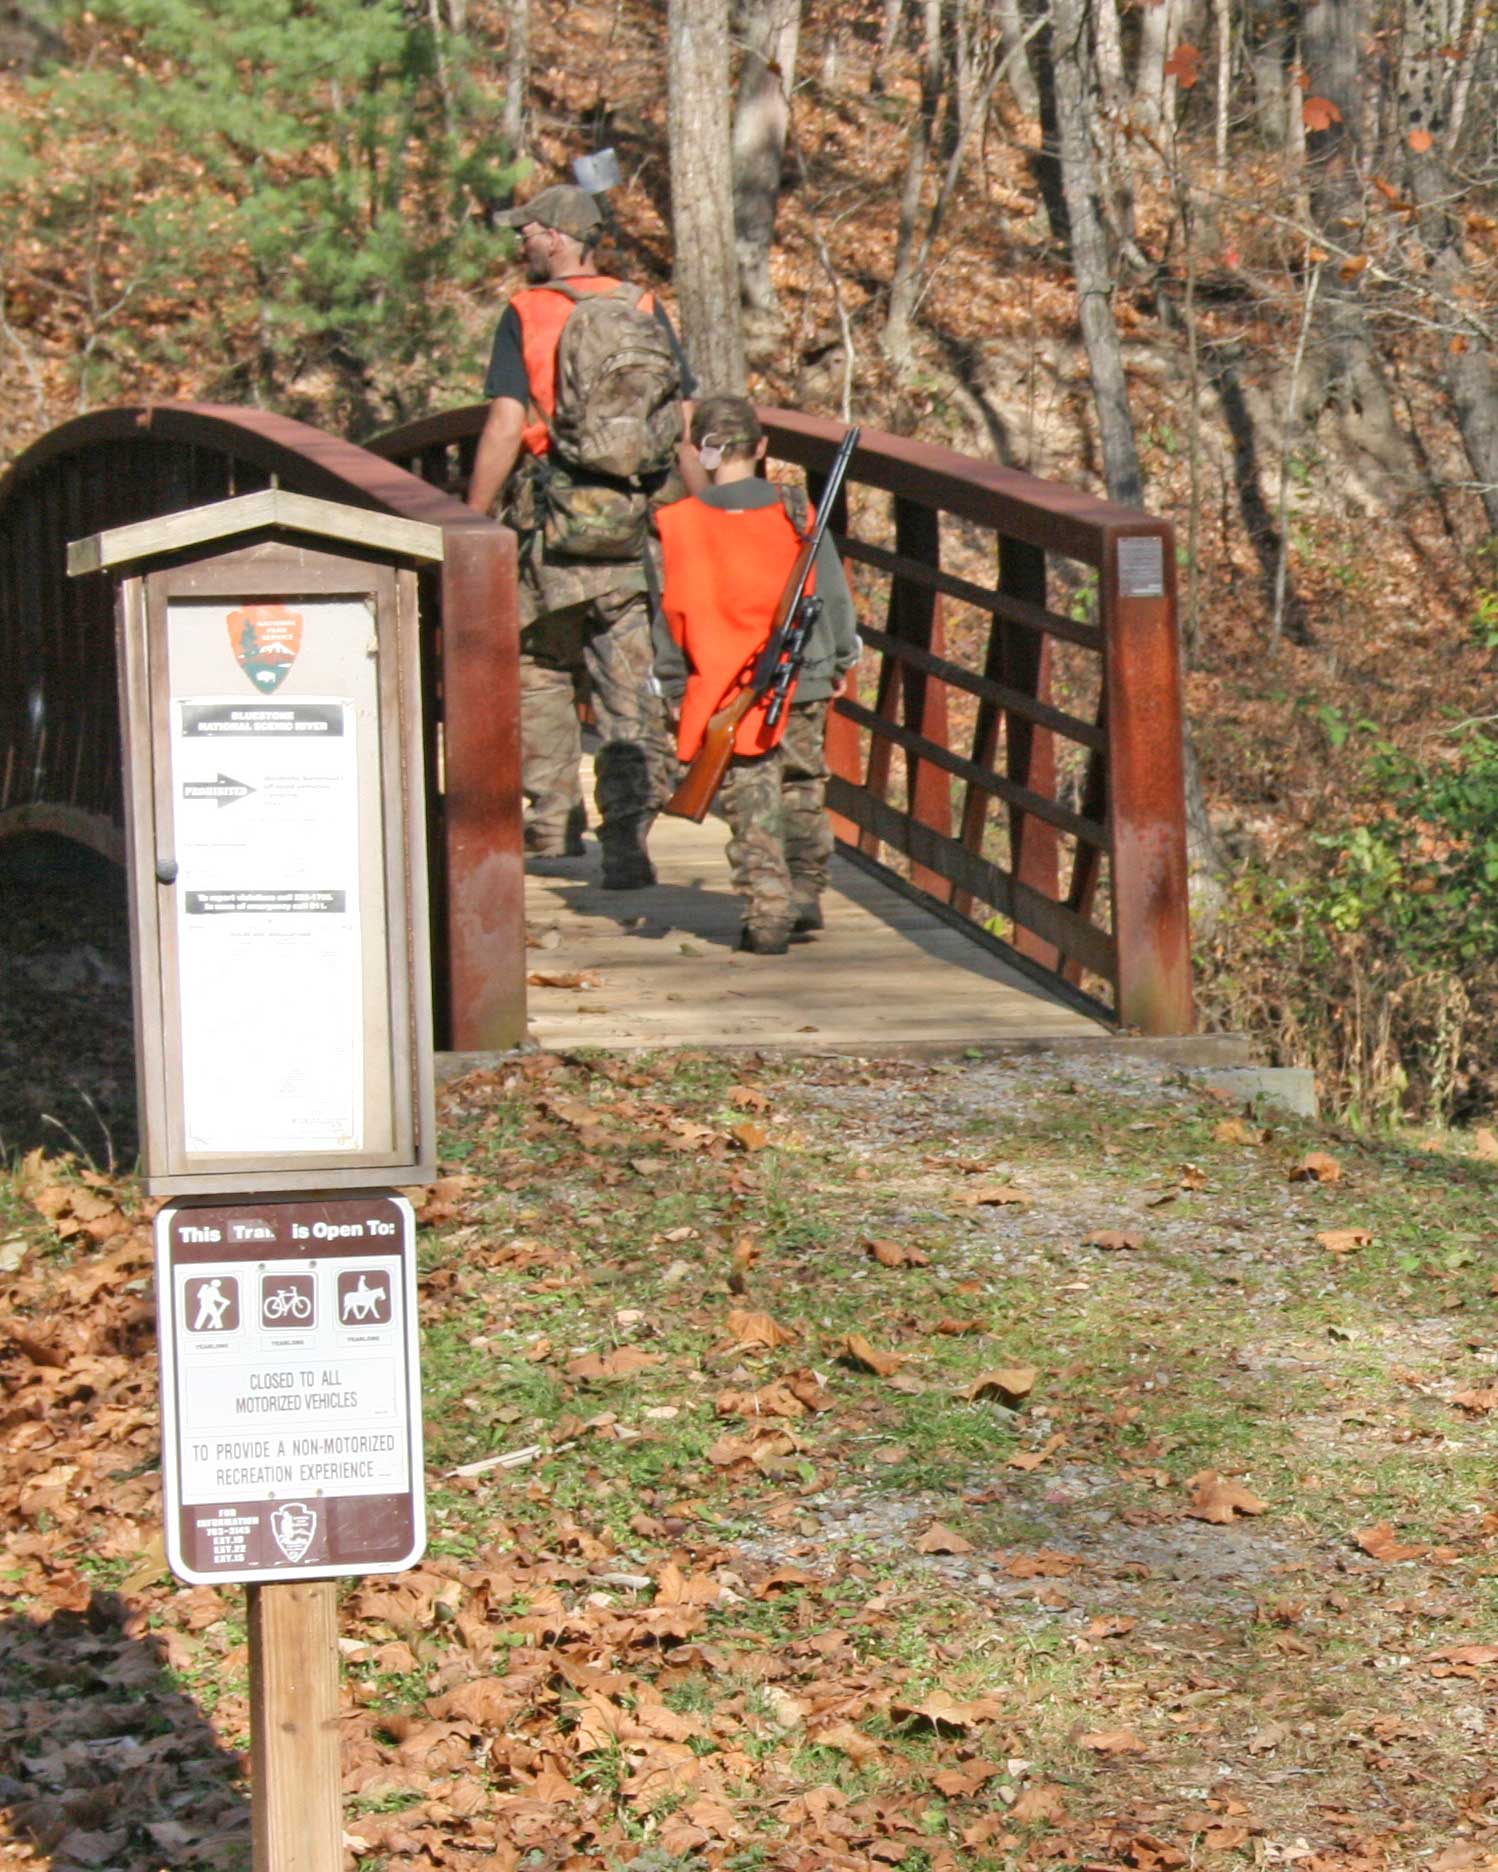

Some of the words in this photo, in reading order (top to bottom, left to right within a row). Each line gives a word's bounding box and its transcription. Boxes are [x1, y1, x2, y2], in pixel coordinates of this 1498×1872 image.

[198, 721, 252, 731] NATIONAL
[253, 721, 293, 731] SCENIC
[178, 1227, 221, 1243] This
[292, 1223, 310, 1239] is
[312, 1221, 364, 1241] Open
[366, 1219, 395, 1236] To:
[250, 1371, 294, 1390] CLOSED
[299, 1370, 314, 1388] TO
[321, 1369, 342, 1386] ALL
[236, 1394, 302, 1414] MOTORIZED
[304, 1391, 358, 1410] VEHICLES
[192, 1444, 209, 1462] TO
[216, 1441, 270, 1460] PROVIDE
[277, 1440, 286, 1457] A
[292, 1434, 395, 1457] NON-MOTORIZED
[216, 1465, 292, 1486] RECREATION
[300, 1460, 374, 1481] EXPERIENCE
[196, 1516, 259, 1528] INFORMATION
